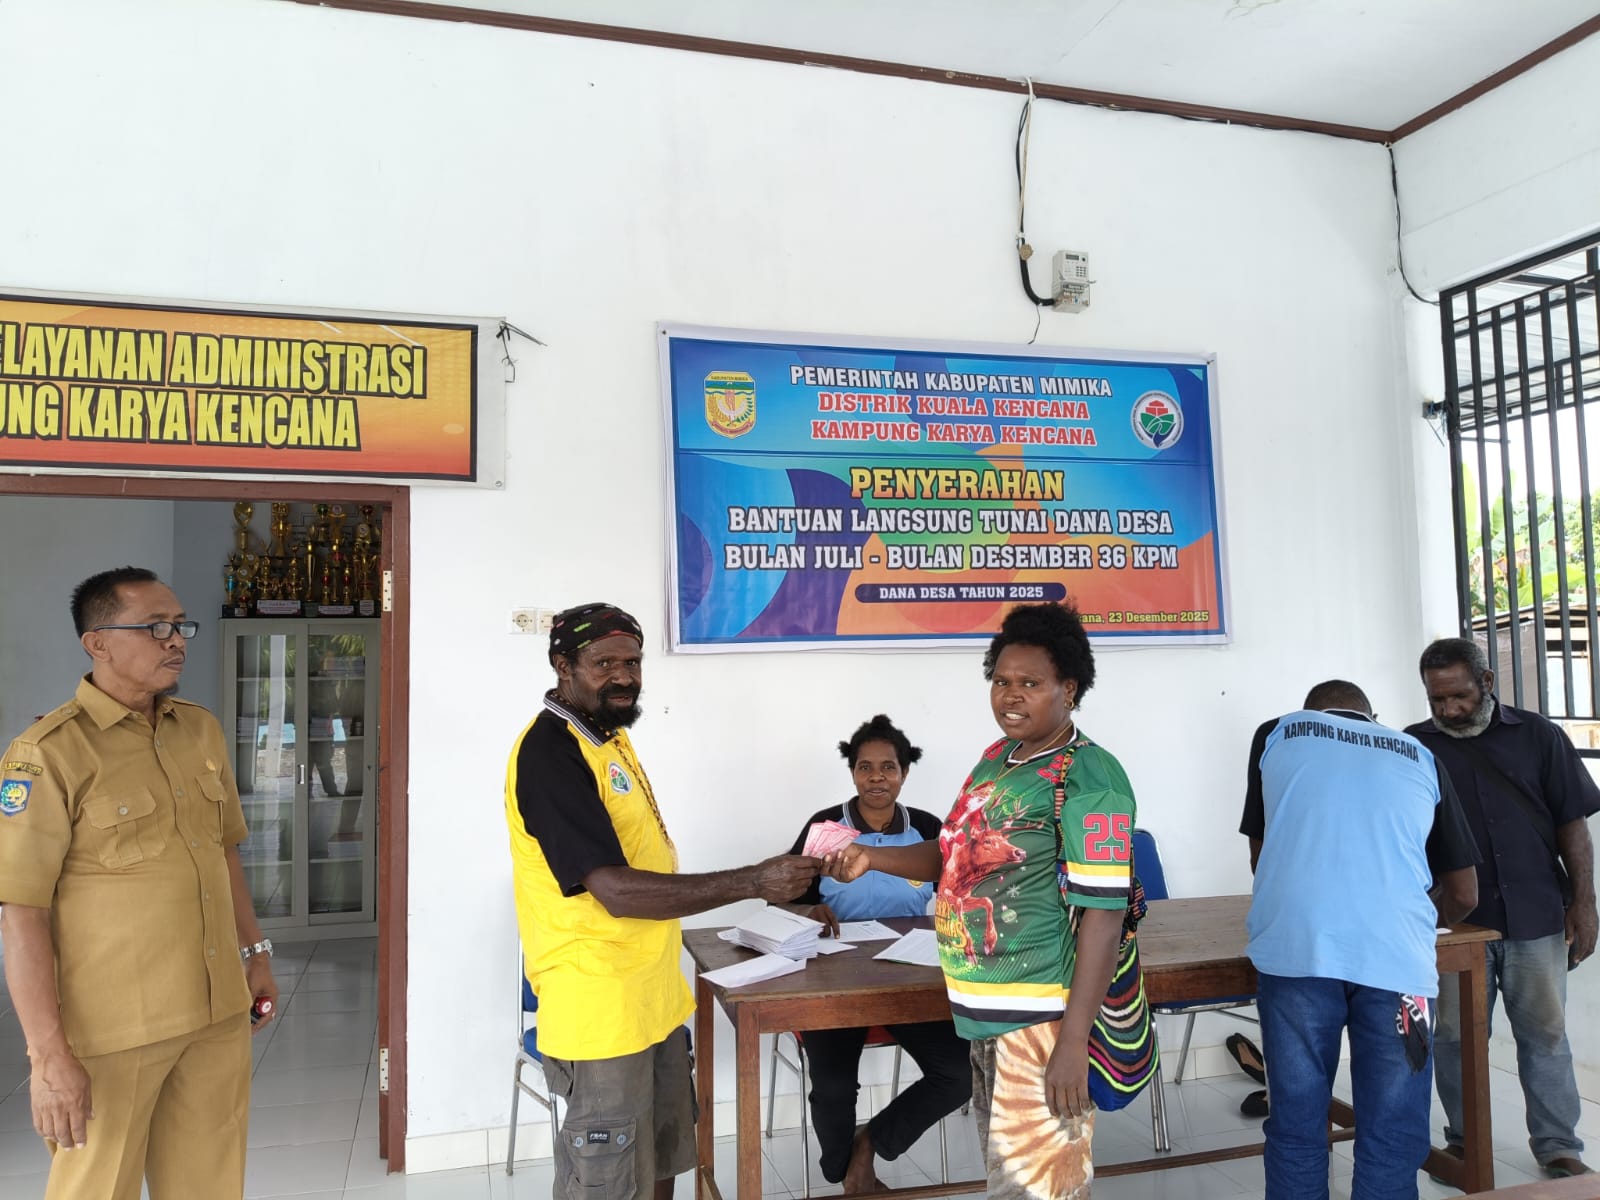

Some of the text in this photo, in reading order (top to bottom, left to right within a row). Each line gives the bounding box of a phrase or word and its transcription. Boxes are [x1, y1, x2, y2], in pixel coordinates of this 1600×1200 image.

[0, 322, 426, 398] LAYANAN ADMINISTRASI
[790, 365, 1112, 397] PEMERINTAH KABUPATEN MIMIKA
[68, 384, 191, 445] KARYA
[195, 390, 361, 451] KENCANA
[818, 393, 1090, 420] DISTRIK KUALA KENCANA
[811, 420, 1097, 446] KAMPUNG KARYA KENCANA
[851, 468, 1065, 500] PENYERAHAN
[728, 506, 1174, 534] BANTUAN LANGSUNG TUNAI DANA DESA
[725, 544, 806, 570] BULAN
[814, 544, 864, 570] JULI
[886, 545, 964, 570] BULAN
[971, 545, 1093, 569] DESEMBER
[1098, 545, 1126, 569] 36
[1132, 545, 1178, 569] KPM
[879, 586, 1043, 599] DANA DESA TAHUN 2025
[1079, 610, 1209, 624] ana, 23 Desember 2025
[1284, 721, 1419, 763] KAMPUNG KARYA KENCANA
[1083, 813, 1131, 862] 25
